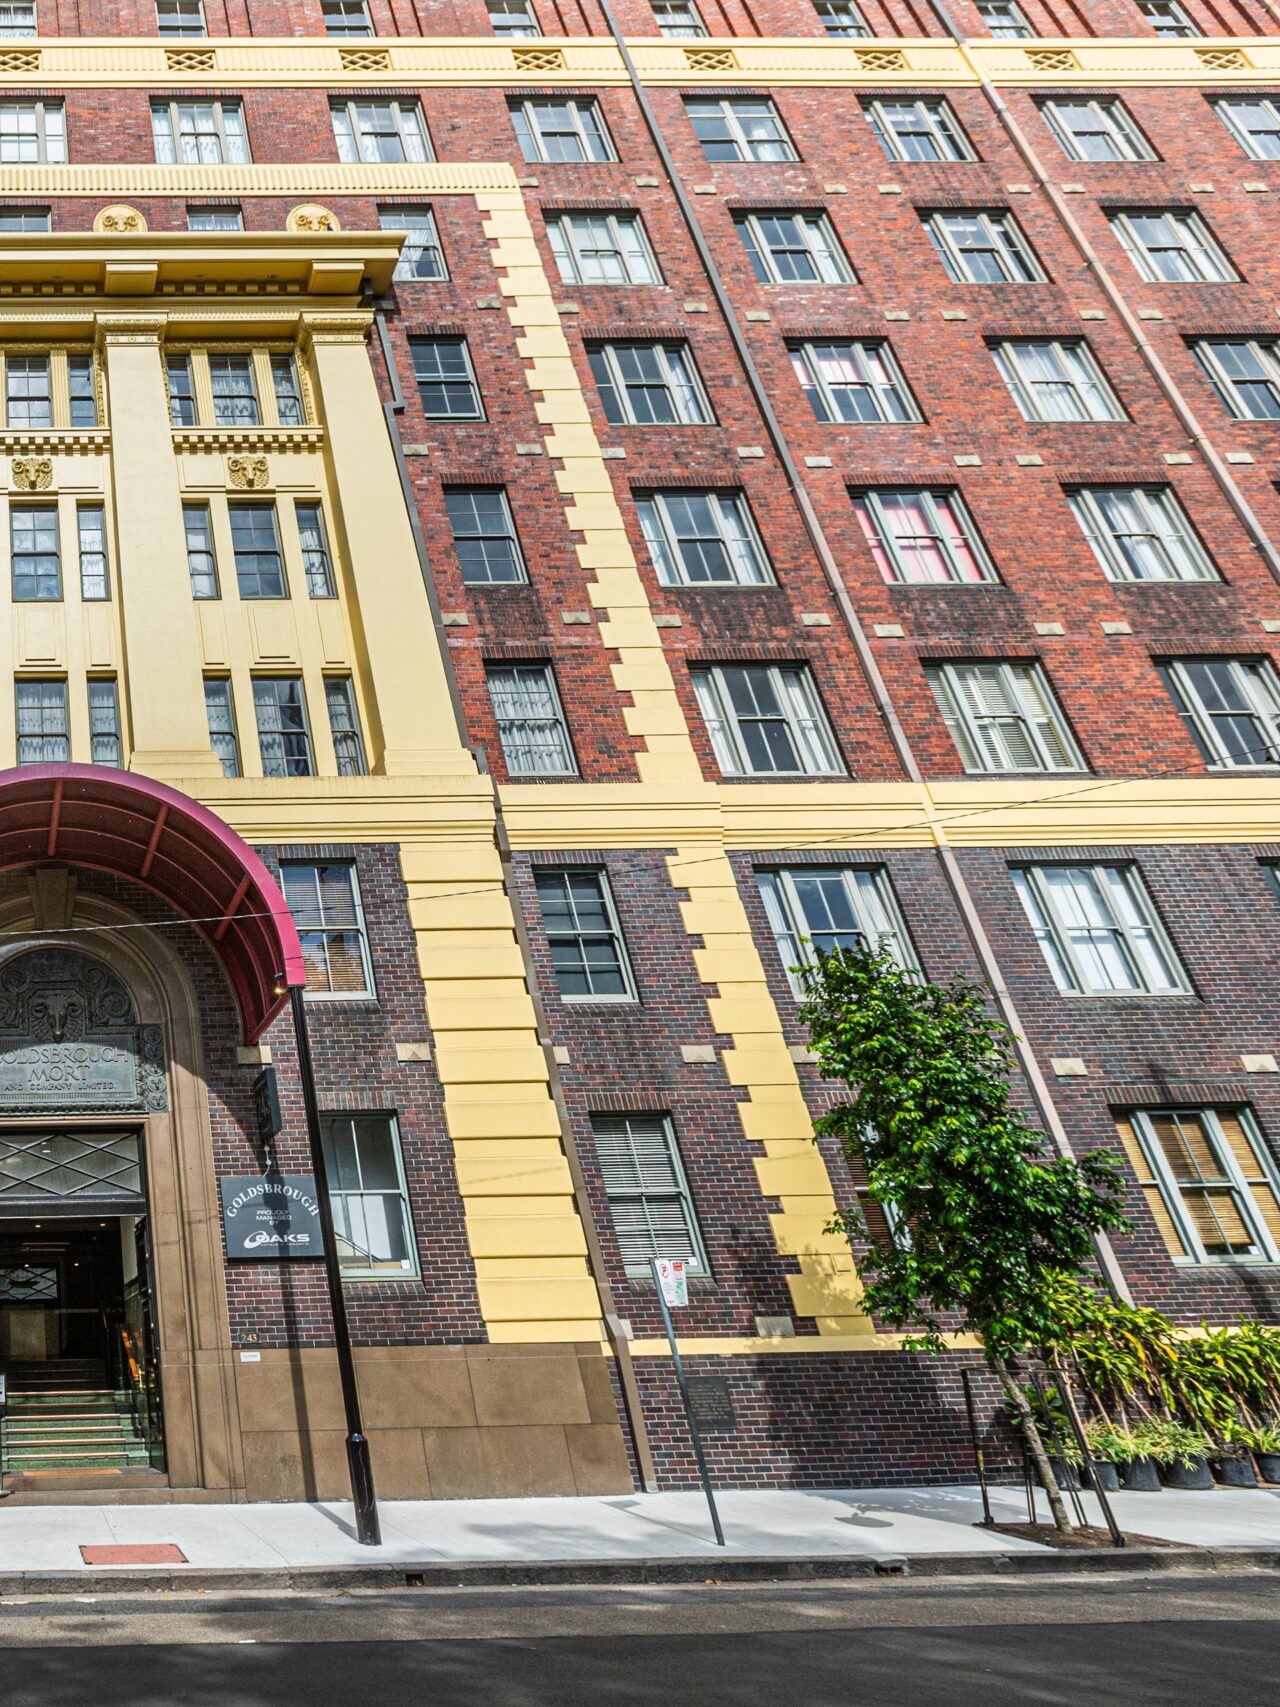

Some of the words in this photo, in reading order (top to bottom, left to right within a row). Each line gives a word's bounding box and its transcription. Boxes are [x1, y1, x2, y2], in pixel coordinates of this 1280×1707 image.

[28, 1065, 91, 1082] MORT
[29, 1083, 73, 1091] COMPANY
[226, 1183, 320, 1218] GOLDSBROUGH
[252, 1233, 310, 1243] OAKS
[240, 1333, 258, 1342] 243
